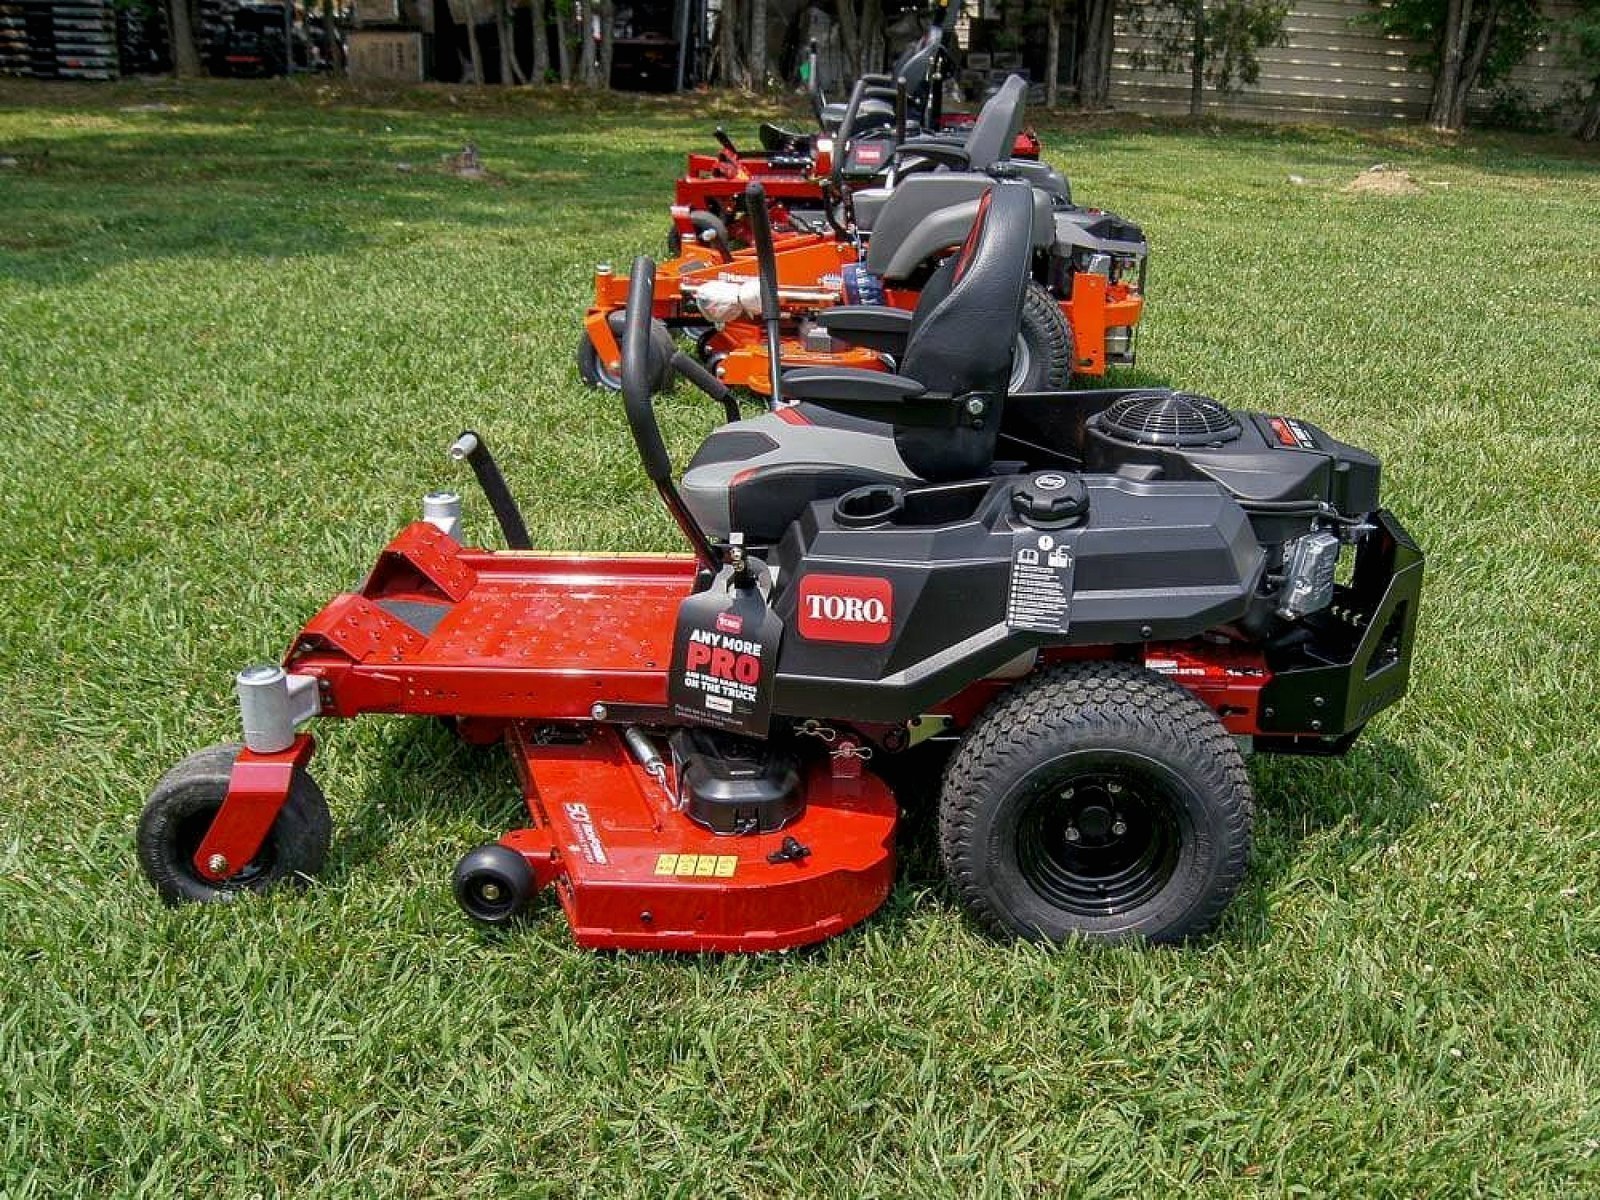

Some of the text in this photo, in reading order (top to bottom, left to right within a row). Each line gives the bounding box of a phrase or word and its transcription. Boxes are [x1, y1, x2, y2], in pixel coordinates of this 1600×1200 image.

[689, 629, 762, 657] ANY MORE
[686, 641, 761, 685] PRO
[684, 677, 756, 702] ON THE TRUCK
